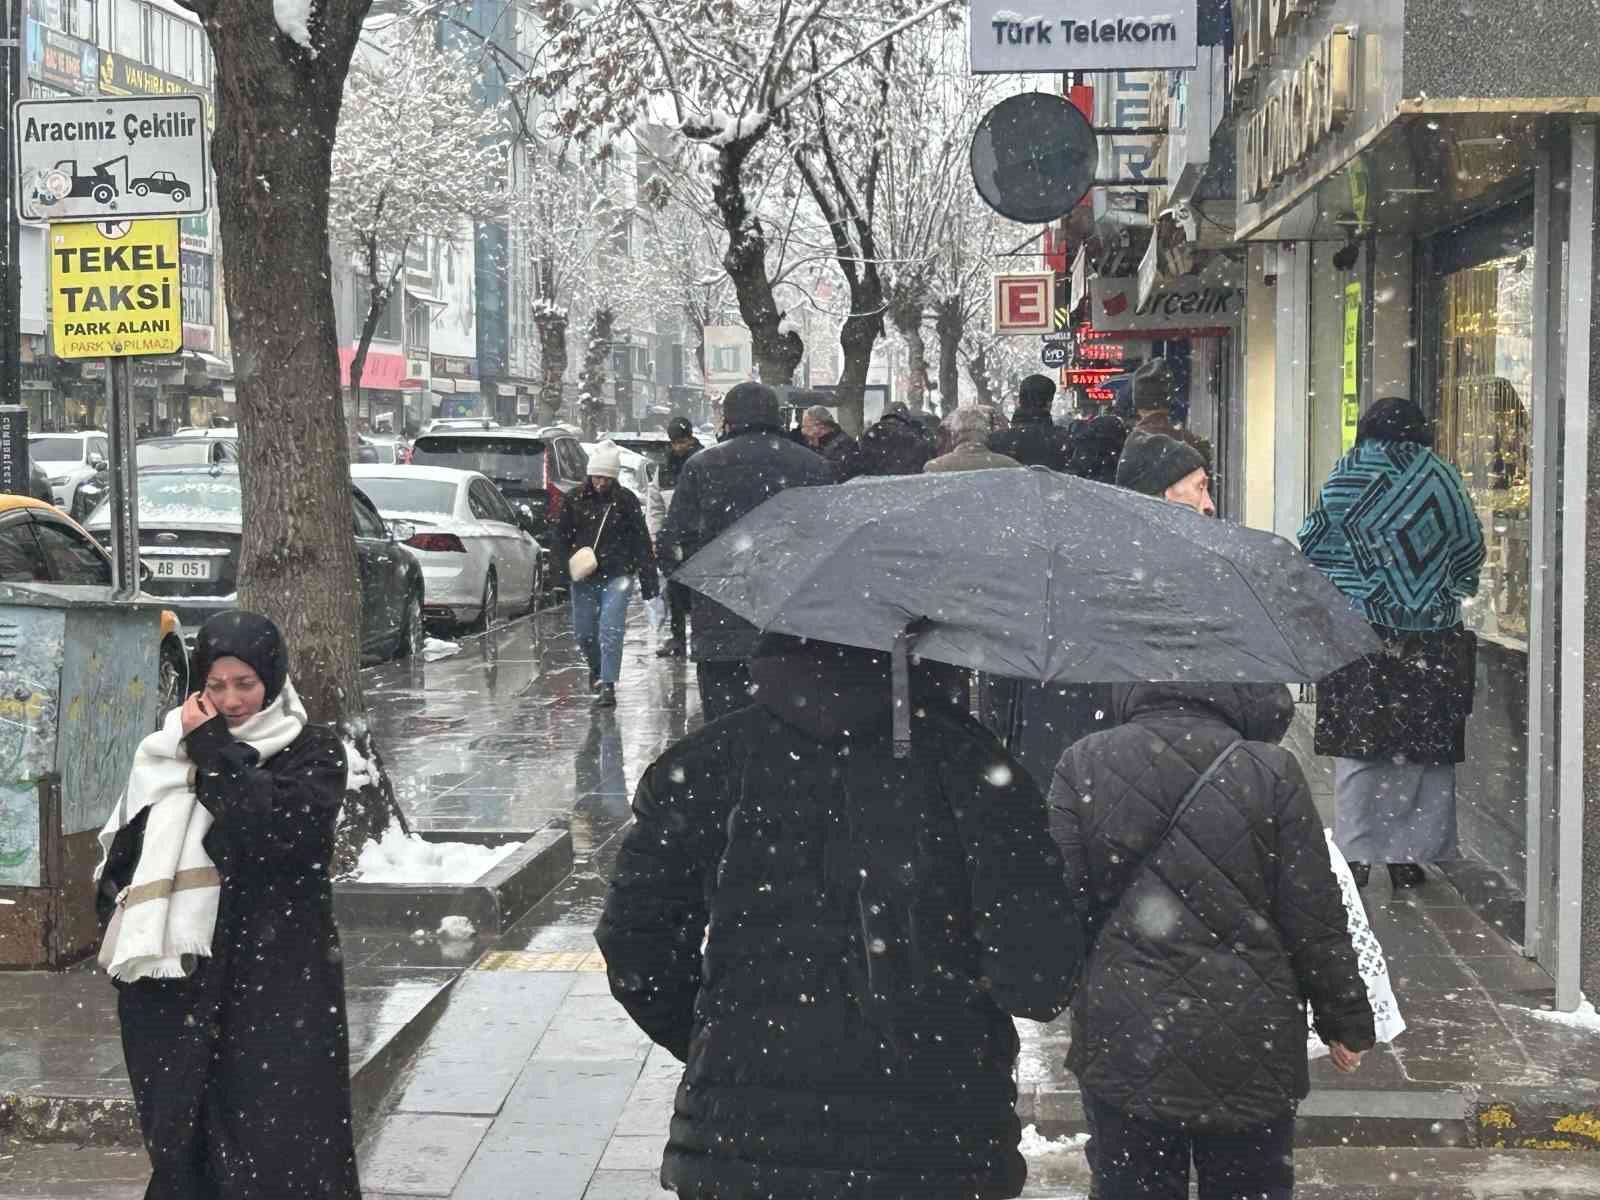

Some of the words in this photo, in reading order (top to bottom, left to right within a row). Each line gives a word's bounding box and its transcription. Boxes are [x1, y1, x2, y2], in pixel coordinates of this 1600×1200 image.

[992, 20, 1052, 44] Türk
[1061, 19, 1177, 43] Telekom
[24, 116, 116, 143] Aracınız
[123, 112, 197, 145] Çekilir
[54, 244, 177, 274] TEKEL
[60, 277, 172, 313] TAKSİ
[1008, 286, 1039, 322] E
[64, 322, 111, 337] PARK
[117, 319, 170, 334] ALANI
[107, 339, 174, 353] YPILMAZ)
[158, 562, 174, 575] AB
[182, 562, 206, 576] 051
